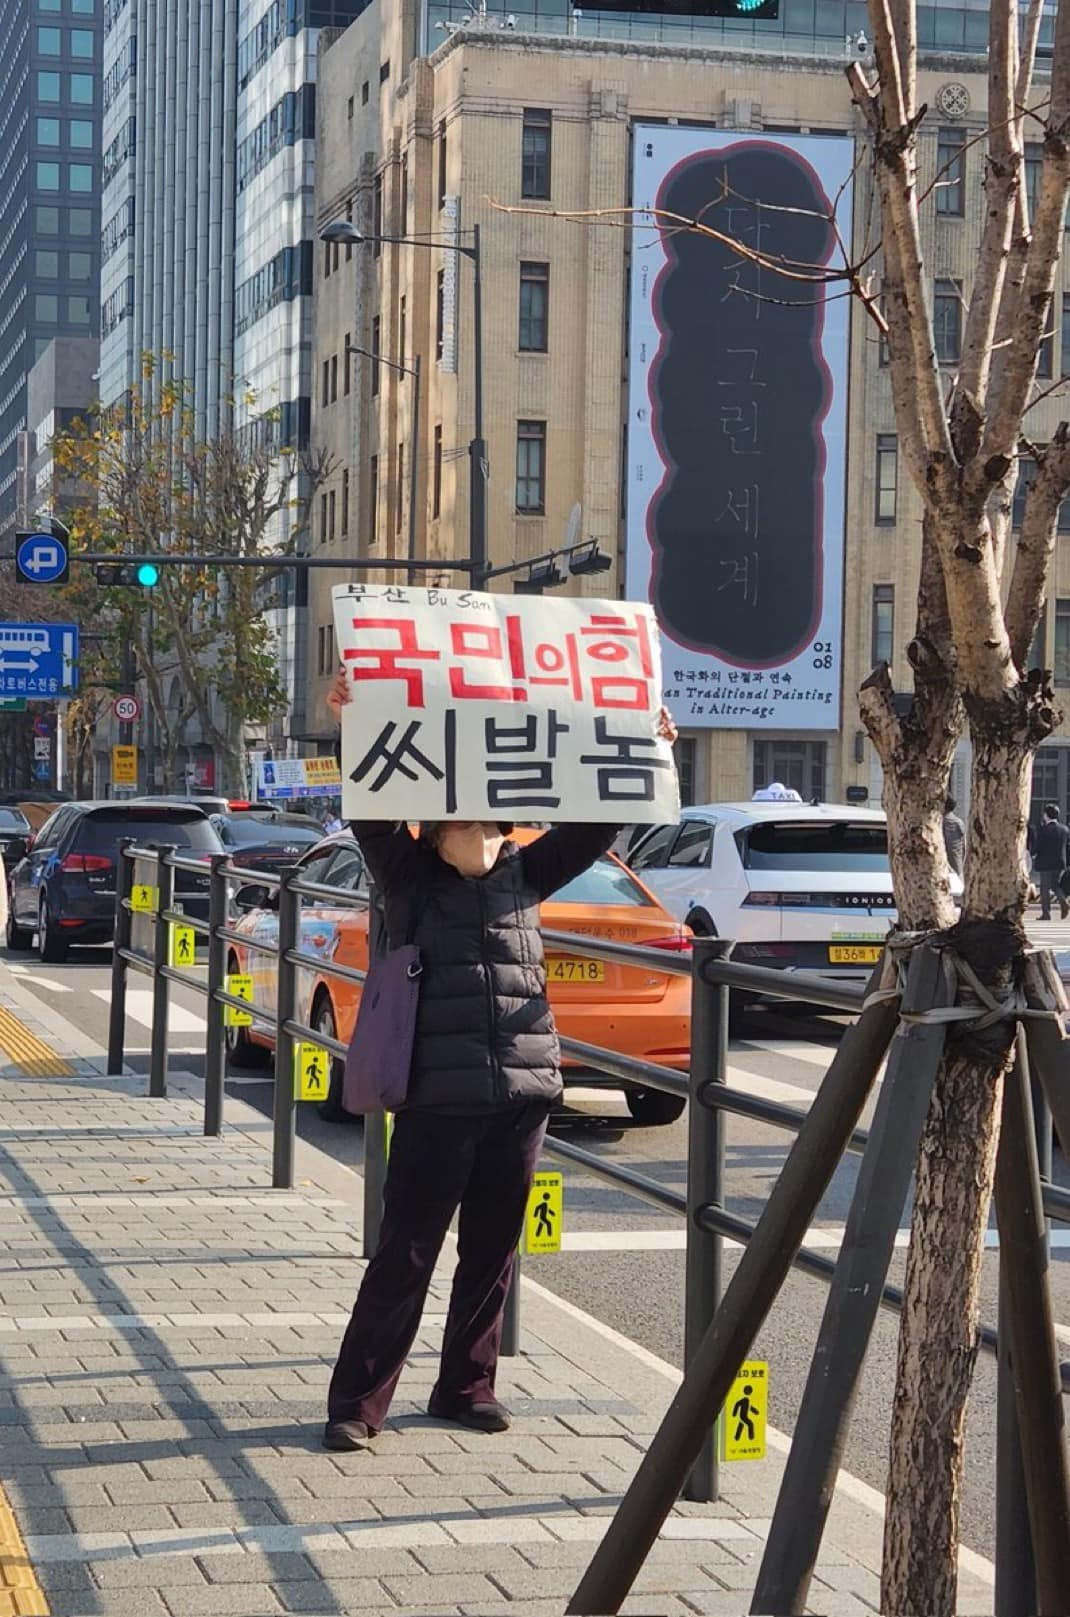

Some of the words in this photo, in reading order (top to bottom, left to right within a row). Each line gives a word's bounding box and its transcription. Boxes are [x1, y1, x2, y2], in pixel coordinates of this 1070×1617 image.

[716, 348, 768, 456] 그린
[714, 483, 762, 608] 세계
[335, 584, 411, 604] 부산
[427, 589, 447, 606] Bu
[813, 642, 832, 652] 01
[344, 615, 654, 710] 국민의힘
[812, 655, 833, 669] 08
[673, 670, 721, 682] 한국화의
[728, 671, 763, 684] 단절과
[769, 672, 792, 684] 연속
[686, 687, 768, 700] Traditional
[772, 689, 833, 704] Painting
[119, 702, 134, 713] 50
[690, 702, 704, 713] in
[708, 703, 775, 718] Alter-age
[349, 708, 670, 814] 씨발놈
[554, 962, 598, 979] 4718
